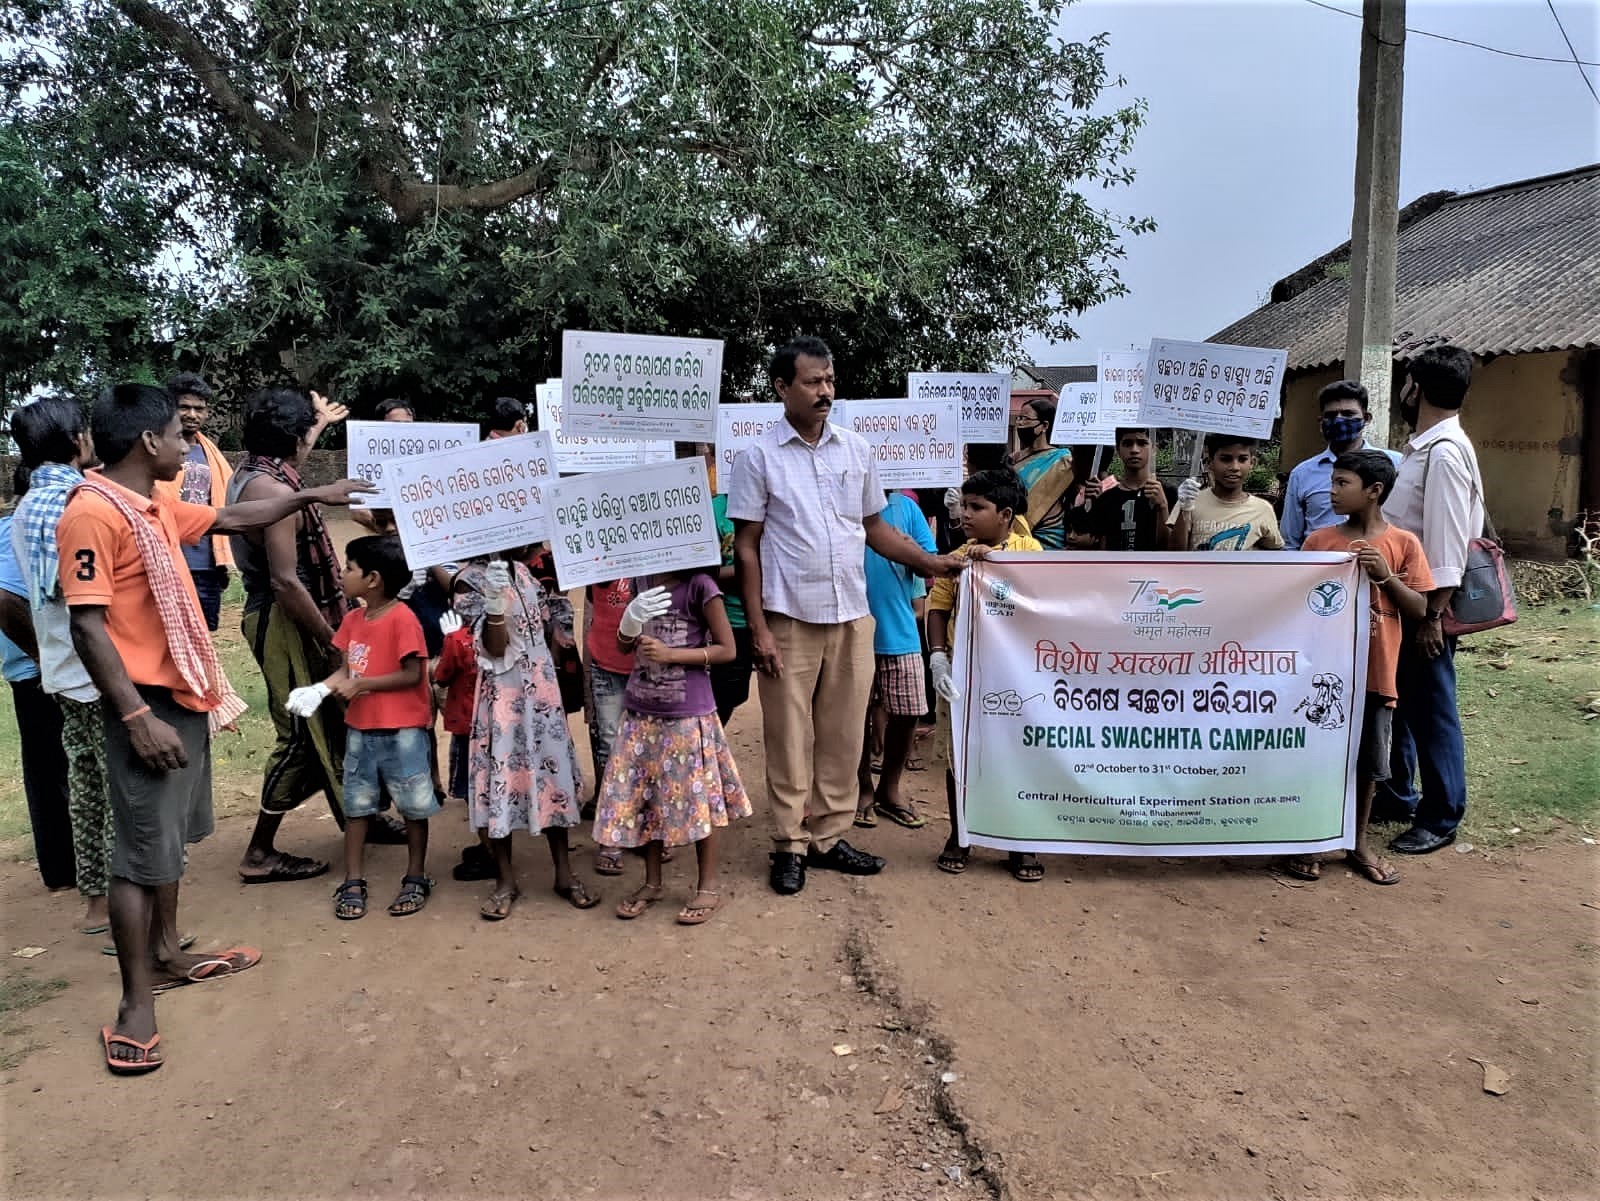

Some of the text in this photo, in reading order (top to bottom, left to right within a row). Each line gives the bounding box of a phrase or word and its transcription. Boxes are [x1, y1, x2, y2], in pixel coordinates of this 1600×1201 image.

[584, 352, 610, 378] ନୂତନ
[635, 355, 671, 376] ରୋପଣ
[674, 351, 703, 378] କରିବା
[1189, 358, 1208, 377] ଅଛି
[1210, 364, 1220, 379] ତ
[1254, 365, 1275, 385] ଅଛି
[573, 378, 624, 411] ପରିବେଶକୁ
[682, 384, 711, 411] ଭରିବା
[1182, 382, 1201, 401] ଅଛି
[1204, 388, 1213, 403] ତ
[1249, 390, 1269, 410] ଅଛି
[664, 485, 701, 508] ମୋତେ
[585, 529, 595, 549] ଓ
[666, 513, 702, 536] ମୋତେ
[75, 549, 97, 582] 3
[986, 609, 1017, 617] ICAR
[1134, 623, 1212, 640] अमृत महोत्सव
[1034, 640, 1300, 675] विशेष स्वच्छता अभियान
[1054, 679, 1120, 712] ବିଶେଷ
[1193, 681, 1277, 715] ଅଭିଯାନ
[1023, 725, 1306, 751] SPECIAL SWACHHTA CAMPAIGN
[1074, 763, 1247, 777] 02nd October to 31st October, 2021
[1017, 790, 1058, 802] Central
[1062, 793, 1136, 806] Horticultural
[1139, 795, 1206, 808] Experiment
[1209, 795, 1250, 805] Station
[1150, 809, 1201, 818] Bhubaneswar
